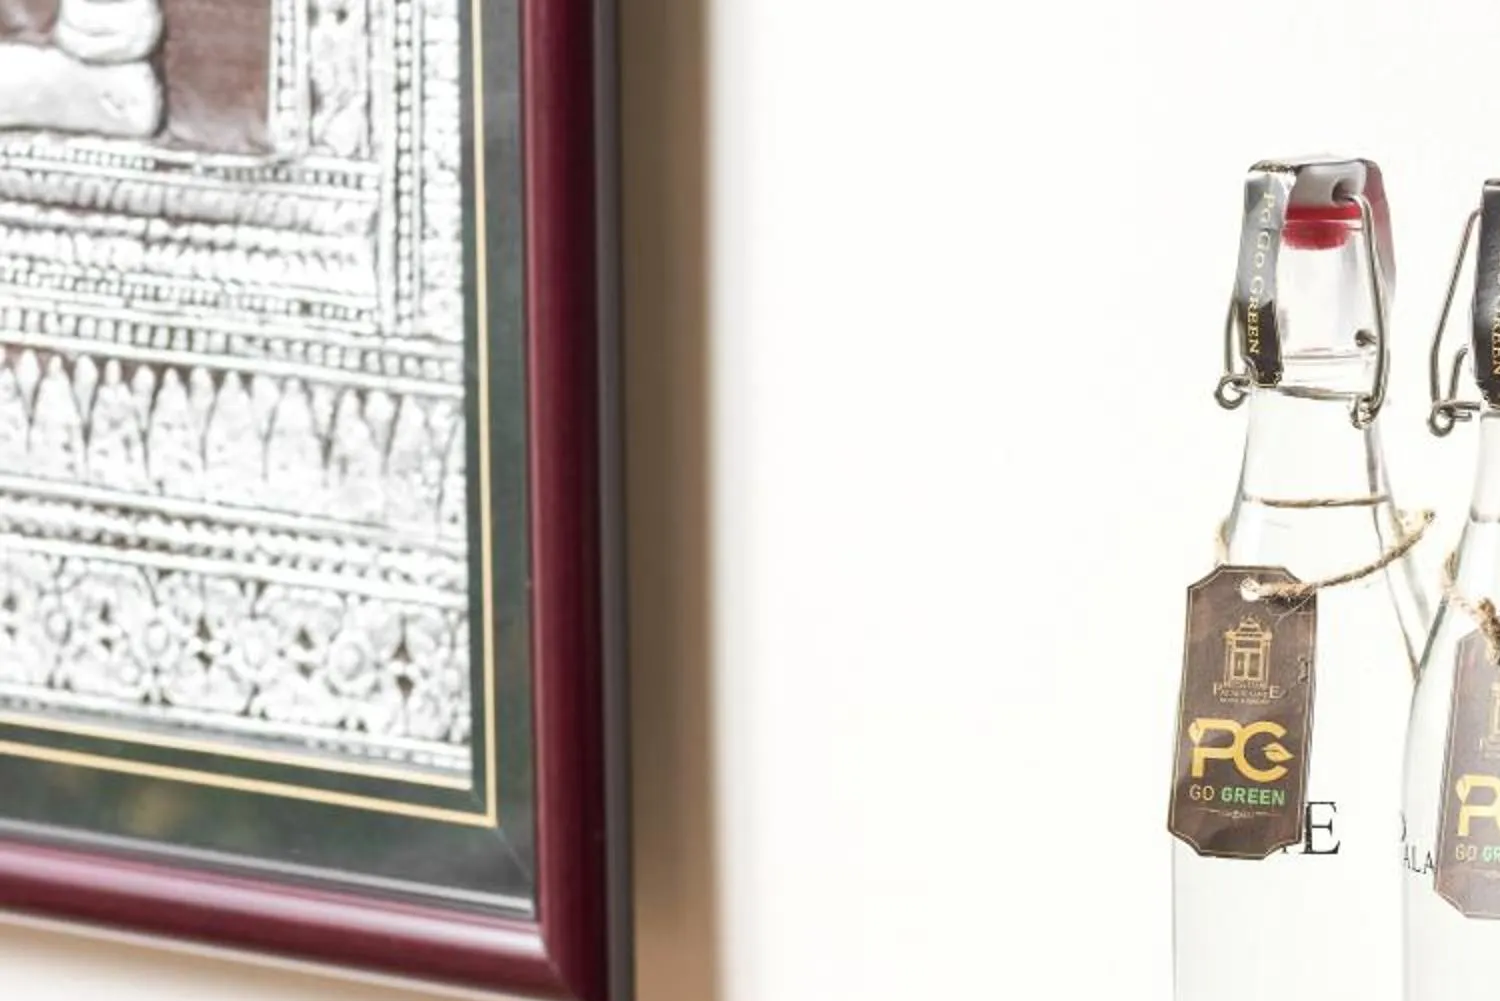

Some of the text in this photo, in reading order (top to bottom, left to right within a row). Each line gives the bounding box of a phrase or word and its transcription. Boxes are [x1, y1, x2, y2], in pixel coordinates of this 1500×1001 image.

[1248, 275, 1265, 354] GREEN
[1189, 785, 1286, 806] GO GREEN
[1456, 843, 1478, 863] GO
